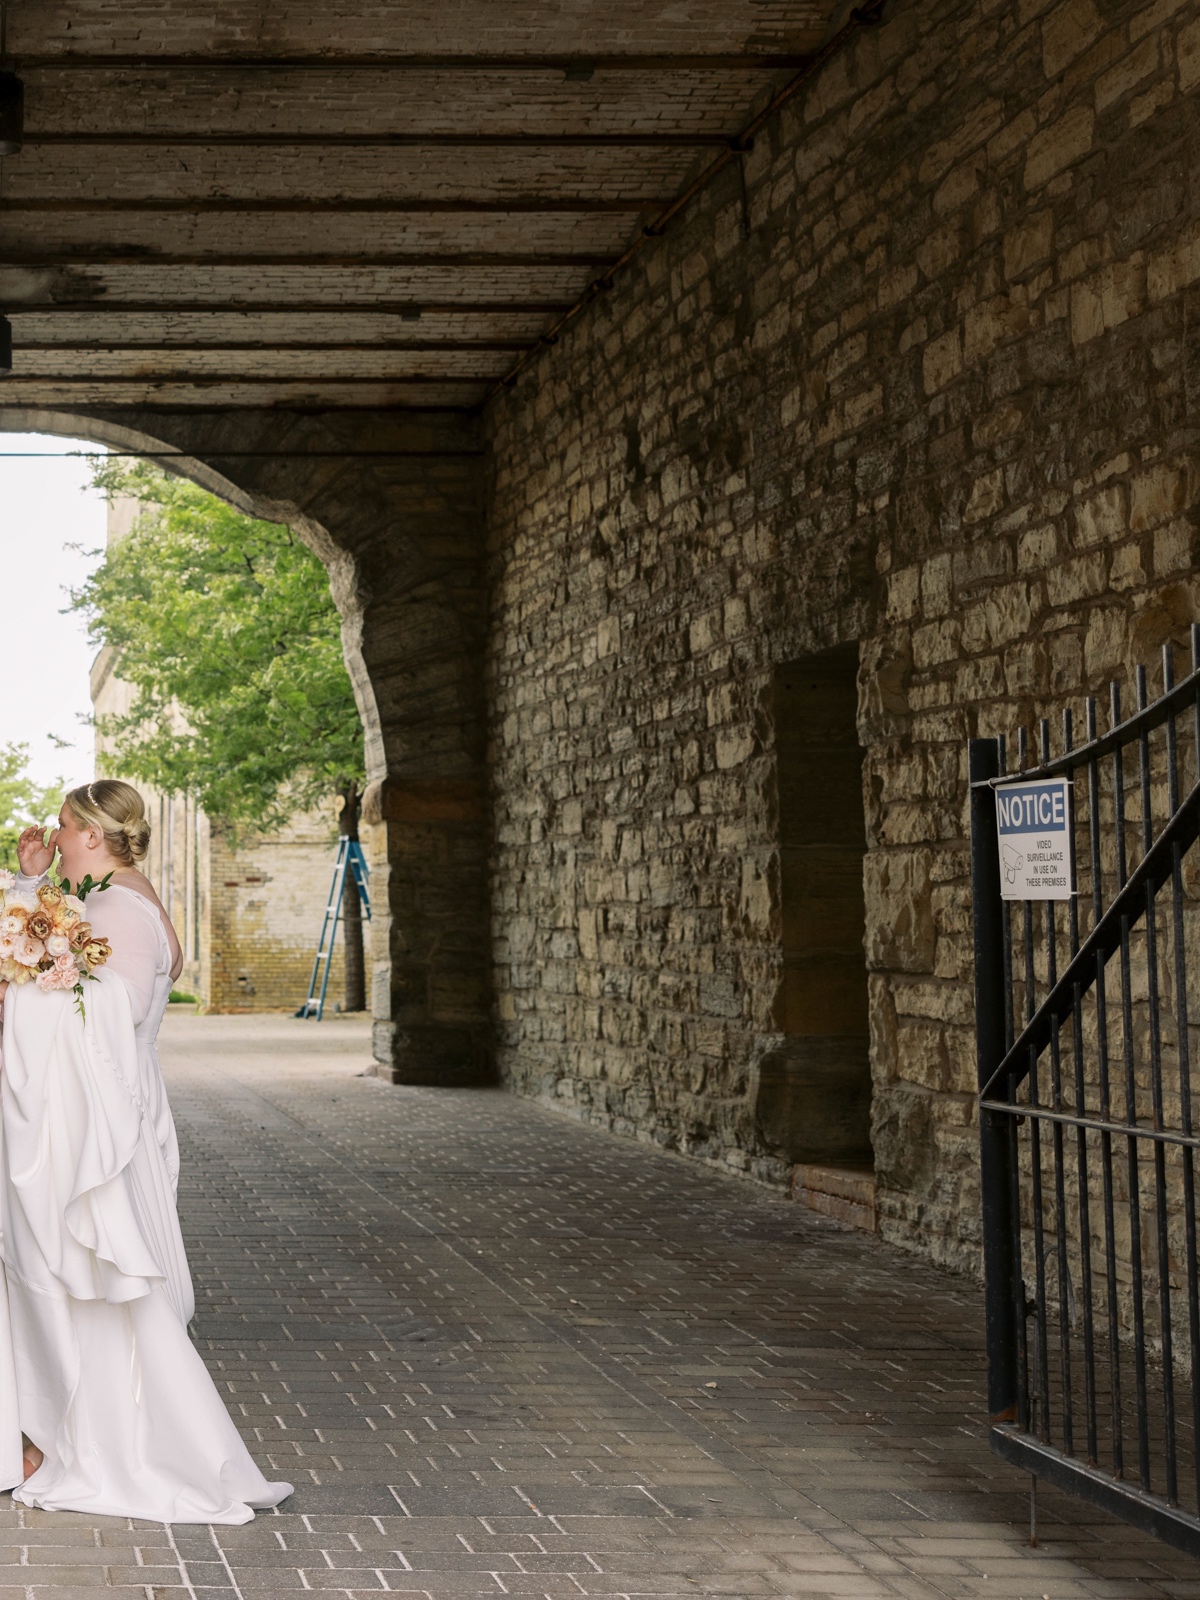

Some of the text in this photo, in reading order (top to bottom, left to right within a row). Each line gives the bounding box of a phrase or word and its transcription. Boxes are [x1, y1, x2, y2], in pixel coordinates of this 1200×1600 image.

[998, 791, 1064, 827] NOTICE
[1036, 840, 1051, 849] VIDEO
[1027, 852, 1063, 862] SURVEILLANCE
[1033, 865, 1057, 874] IN USE ON
[1026, 877, 1066, 886] THESE PREMISES
